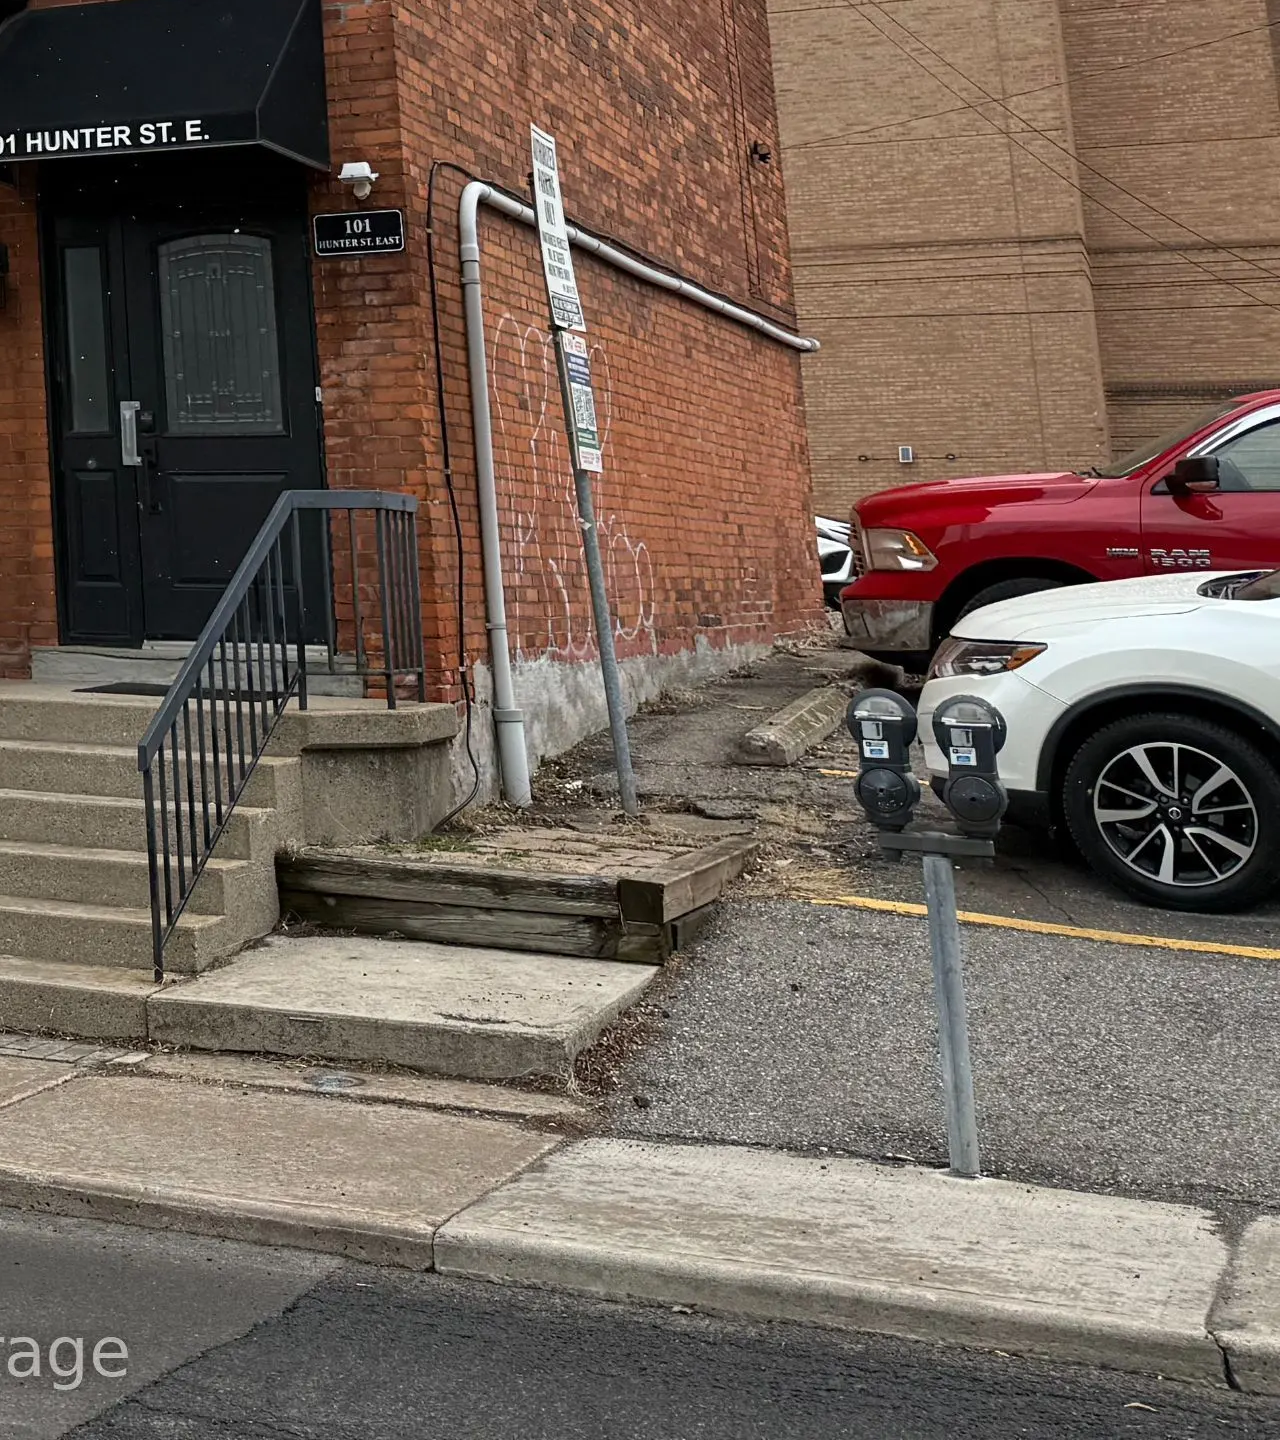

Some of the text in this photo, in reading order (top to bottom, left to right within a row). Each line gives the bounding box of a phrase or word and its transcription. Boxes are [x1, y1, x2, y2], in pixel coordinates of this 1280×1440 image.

[26, 125, 132, 153] HUNTER
[139, 121, 177, 145] ST.
[185, 119, 210, 142] E.
[344, 218, 372, 234] 101
[319, 235, 401, 249] HUNTER ST. EAST
[1150, 548, 1211, 557] RAM
[1151, 557, 1211, 567] 1500
